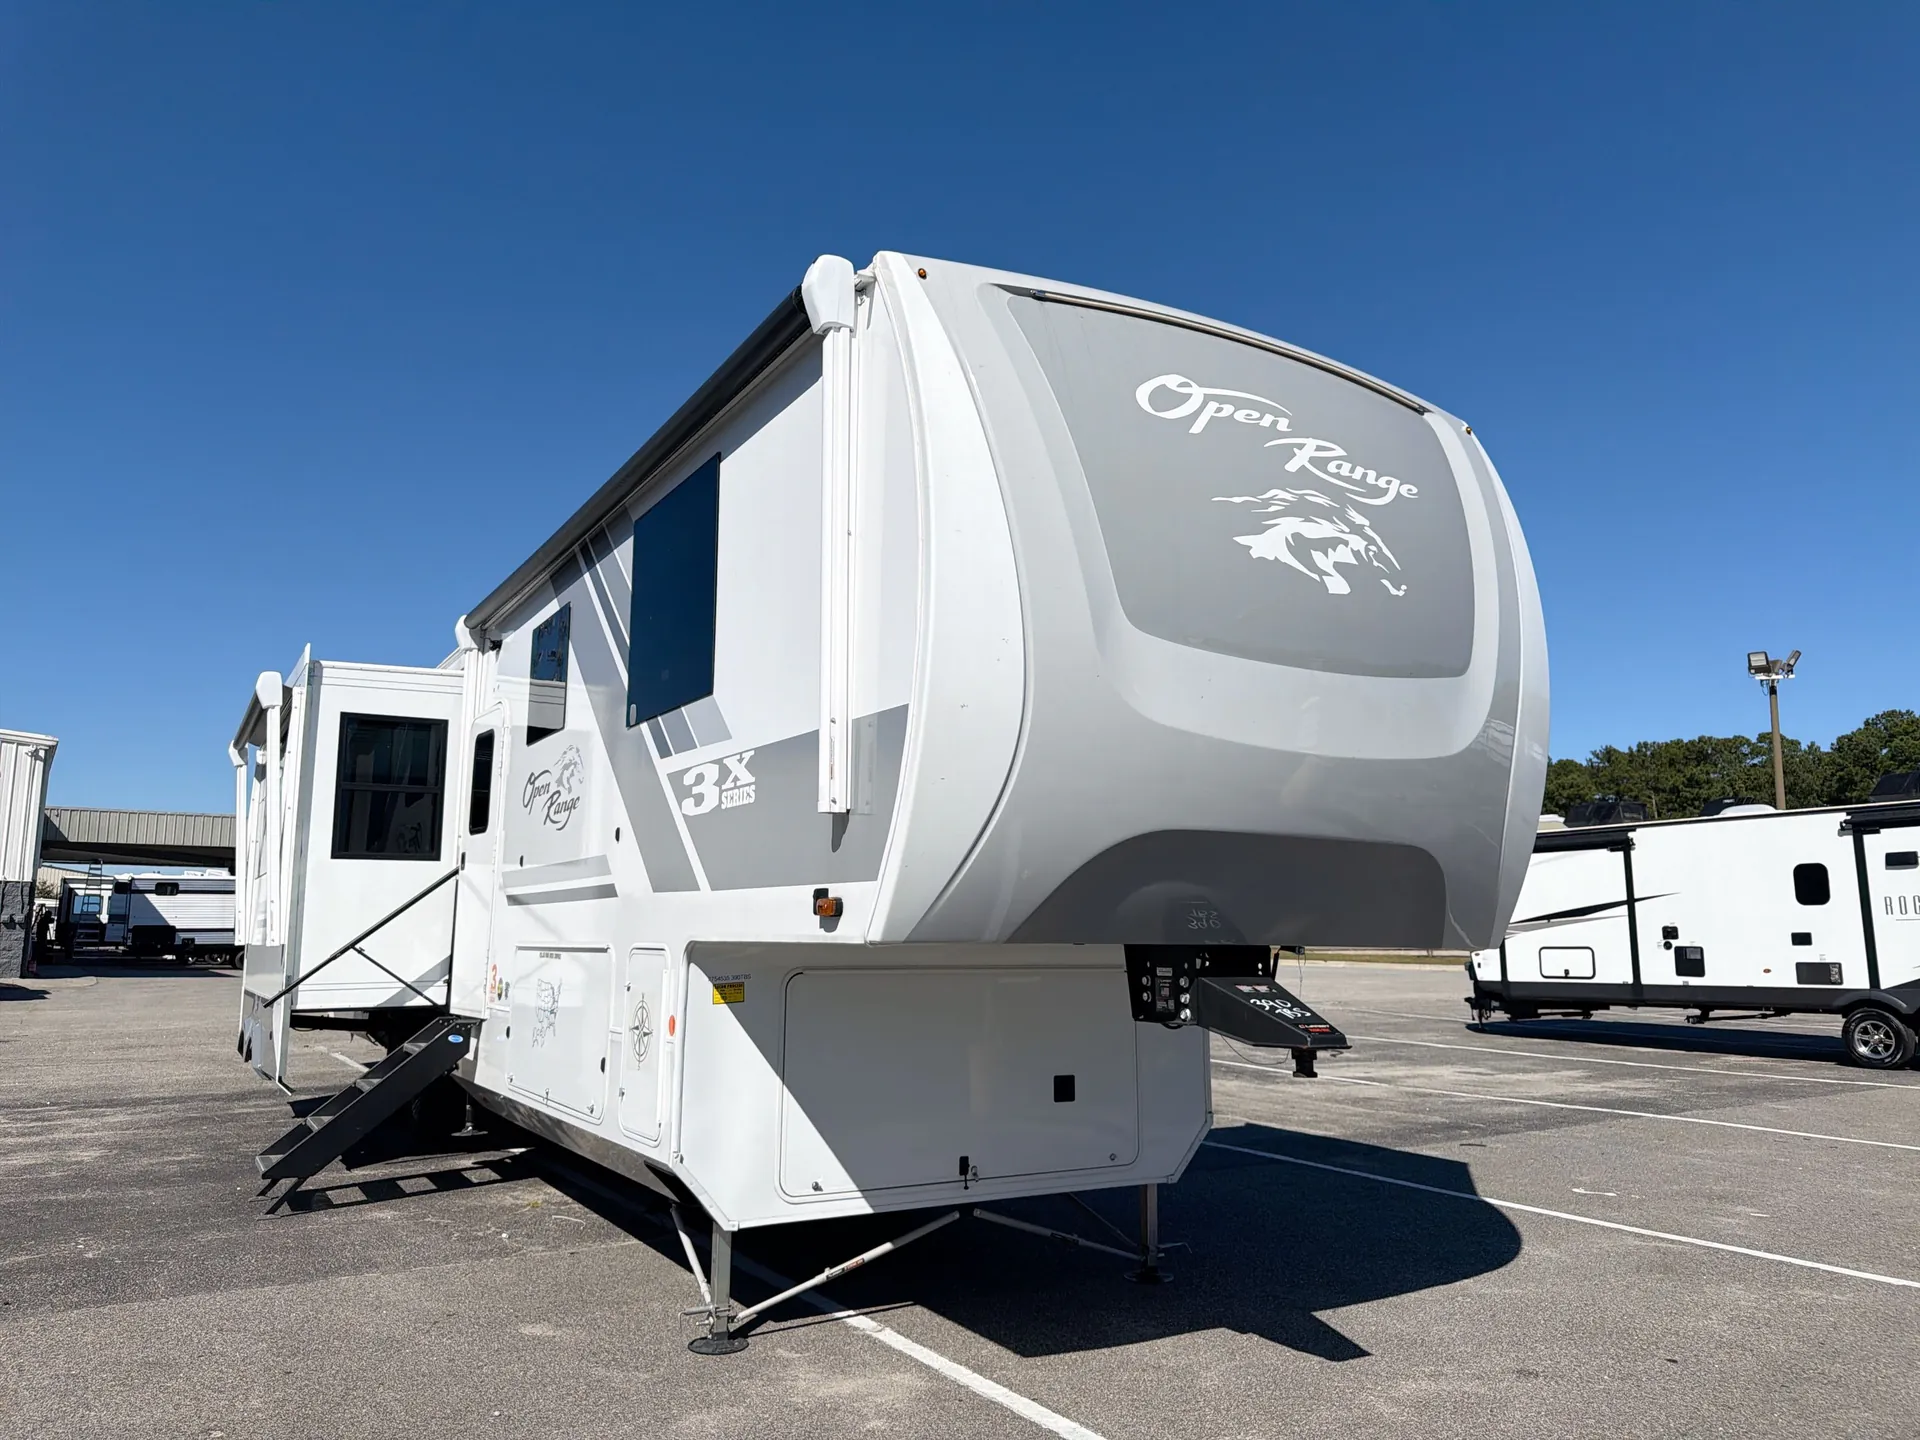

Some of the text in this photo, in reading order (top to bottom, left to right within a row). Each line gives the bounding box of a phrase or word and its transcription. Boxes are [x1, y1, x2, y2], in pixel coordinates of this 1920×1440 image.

[1136, 374, 1292, 433] Open
[1264, 437, 1419, 505] Range
[523, 769, 552, 815] Open
[541, 790, 580, 831] Range
[721, 785, 755, 810] SERIES
[1250, 999, 1291, 1011] 390
[1275, 1007, 1312, 1020] TBS
